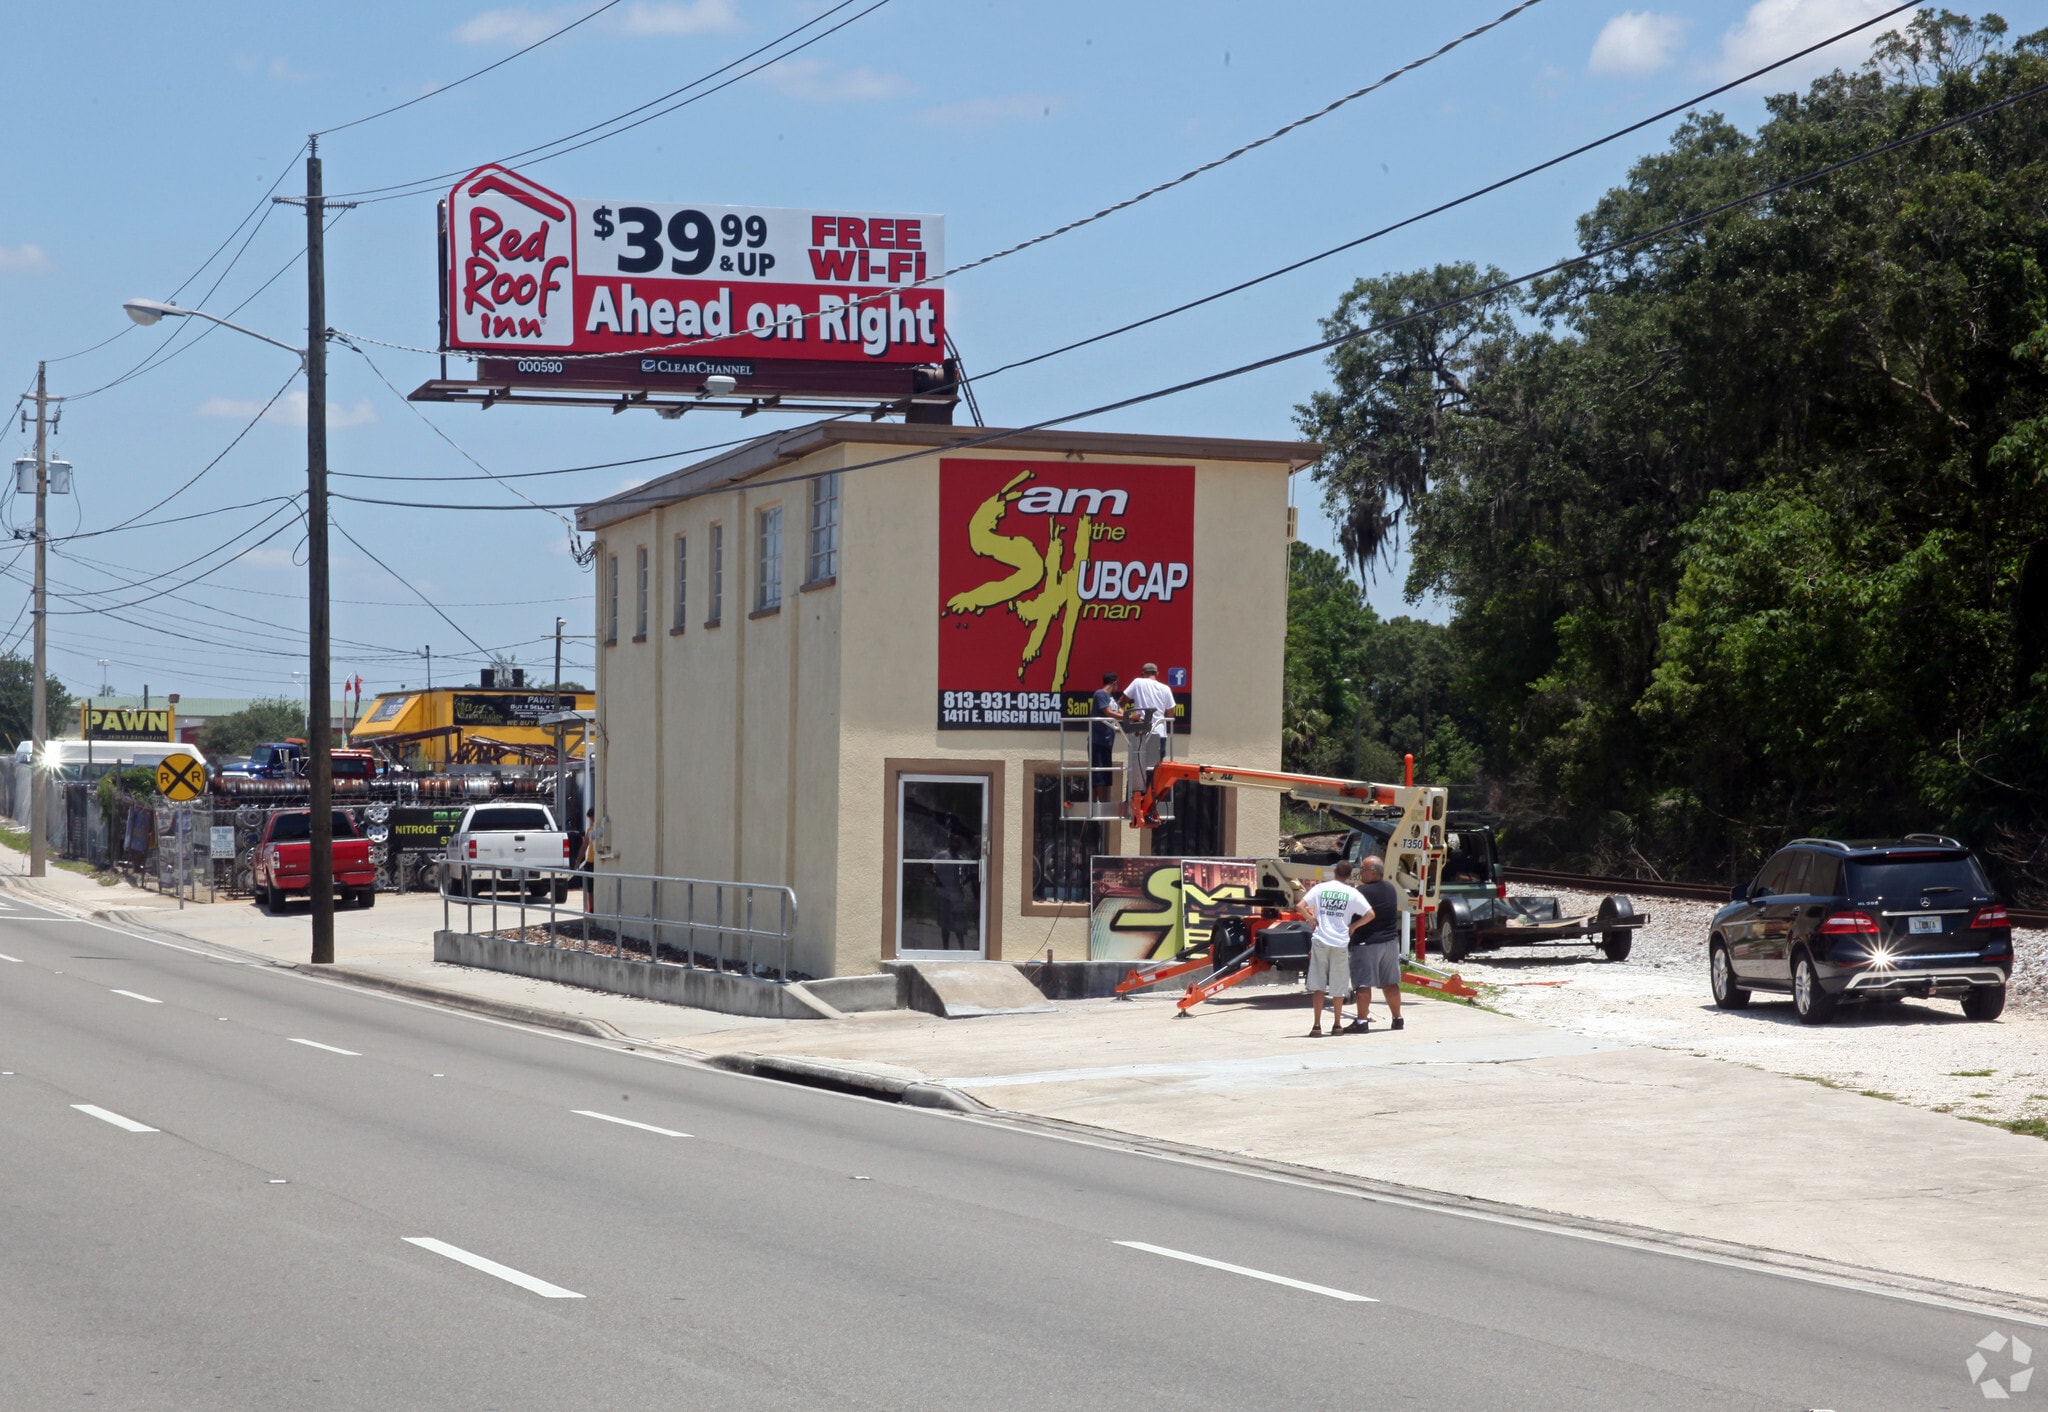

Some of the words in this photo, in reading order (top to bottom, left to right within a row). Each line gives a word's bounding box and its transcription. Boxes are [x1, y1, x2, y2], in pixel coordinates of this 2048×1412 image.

[470, 206, 549, 262] Red
[811, 215, 922, 250] FREE
[463, 256, 569, 318] Roof
[585, 283, 732, 337] Ahead
[746, 302, 804, 340] on
[818, 293, 938, 356] Right
[517, 360, 564, 374] 000590
[1091, 522, 1126, 541] the
[1082, 603, 1142, 620] man
[943, 691, 1062, 710] 813-931-0354
[85, 710, 168, 732] PAWN
[942, 709, 970, 723] 1411
[971, 710, 982, 723] E.
[984, 710, 1028, 724] BUSCH
[1030, 710, 1062, 724] BLVD
[1402, 838, 1423, 849] T350
